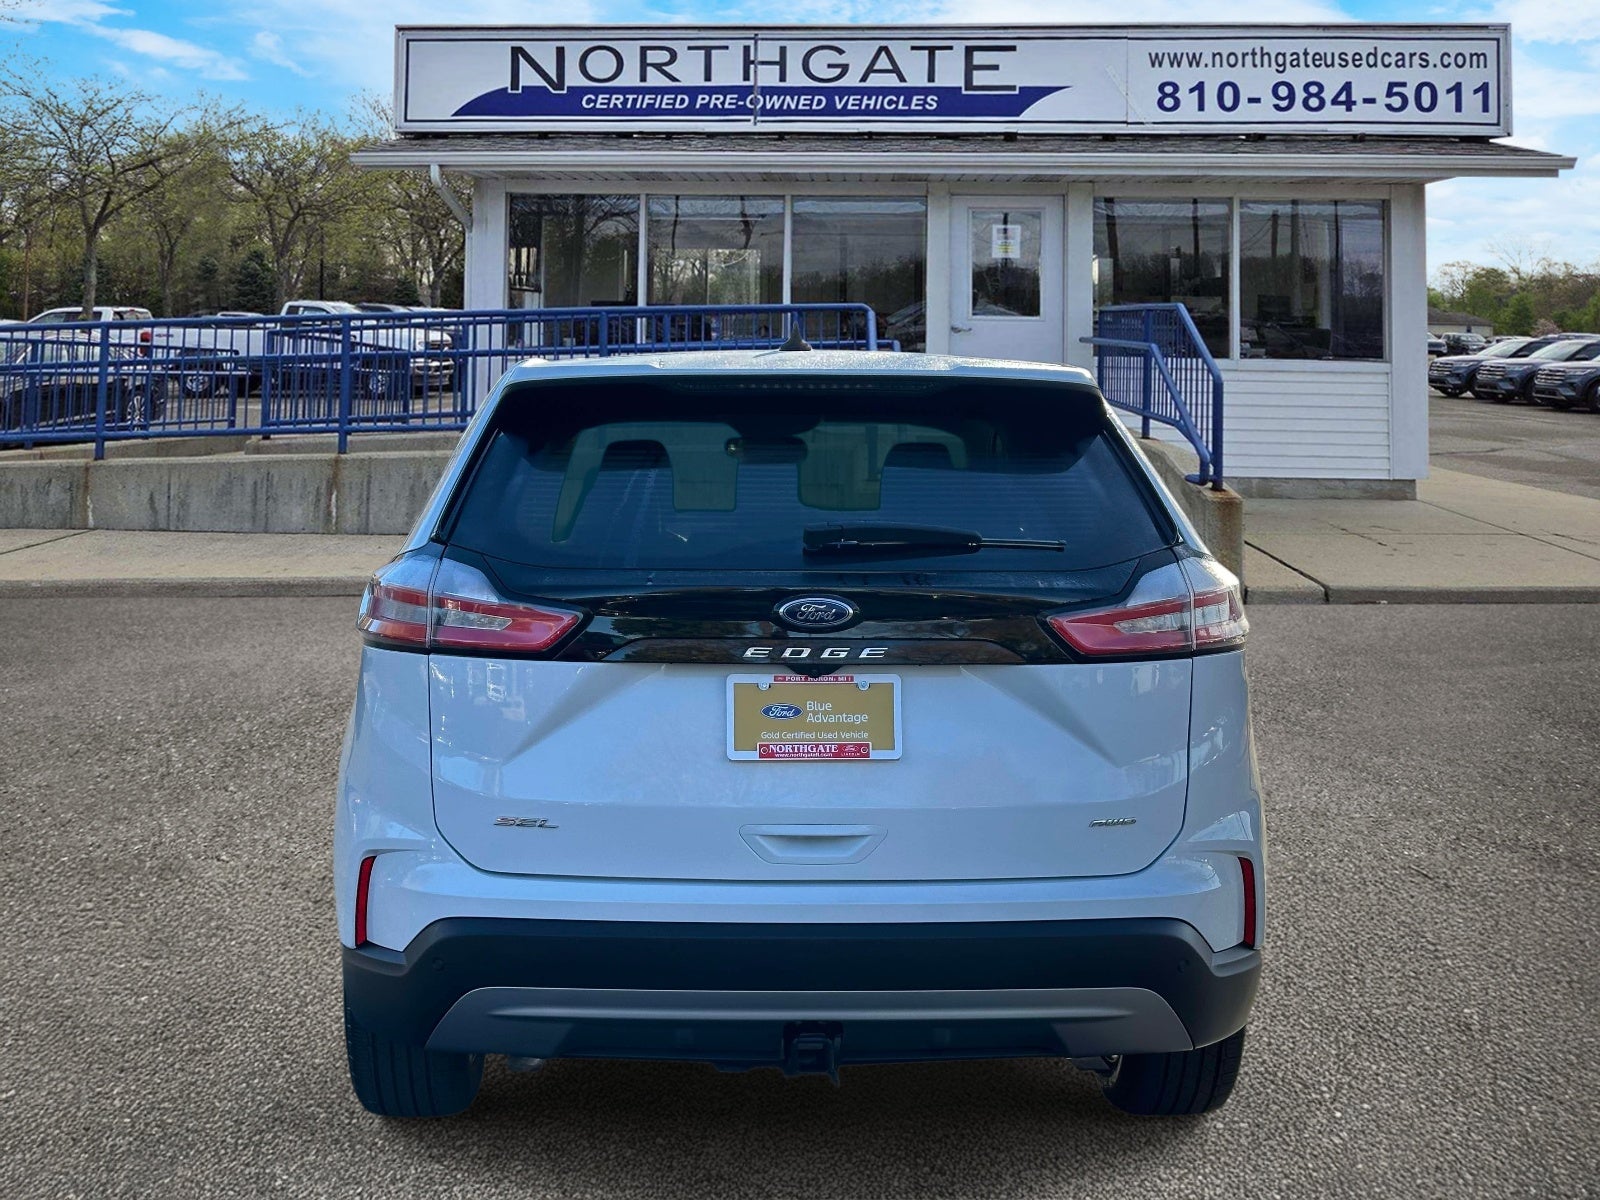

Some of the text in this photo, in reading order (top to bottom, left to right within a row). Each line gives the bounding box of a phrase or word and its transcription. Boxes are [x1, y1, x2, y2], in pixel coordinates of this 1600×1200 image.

[1148, 46, 1489, 73] www.northgateusedcars.com
[510, 44, 1017, 93] NORTHGATE
[581, 93, 939, 110] CERTIFIED PRE-OWNED VEHICLES
[1156, 80, 1492, 113] 810-984-5011
[796, 603, 836, 621] Ford
[742, 647, 889, 659] EDGE
[768, 705, 796, 718] Ford
[806, 701, 833, 711] Blue
[806, 713, 869, 724] Advantage
[760, 731, 869, 739] Gold Certified Used Vehicle
[769, 744, 839, 753] NORTHGATE
[493, 816, 560, 829] SEL
